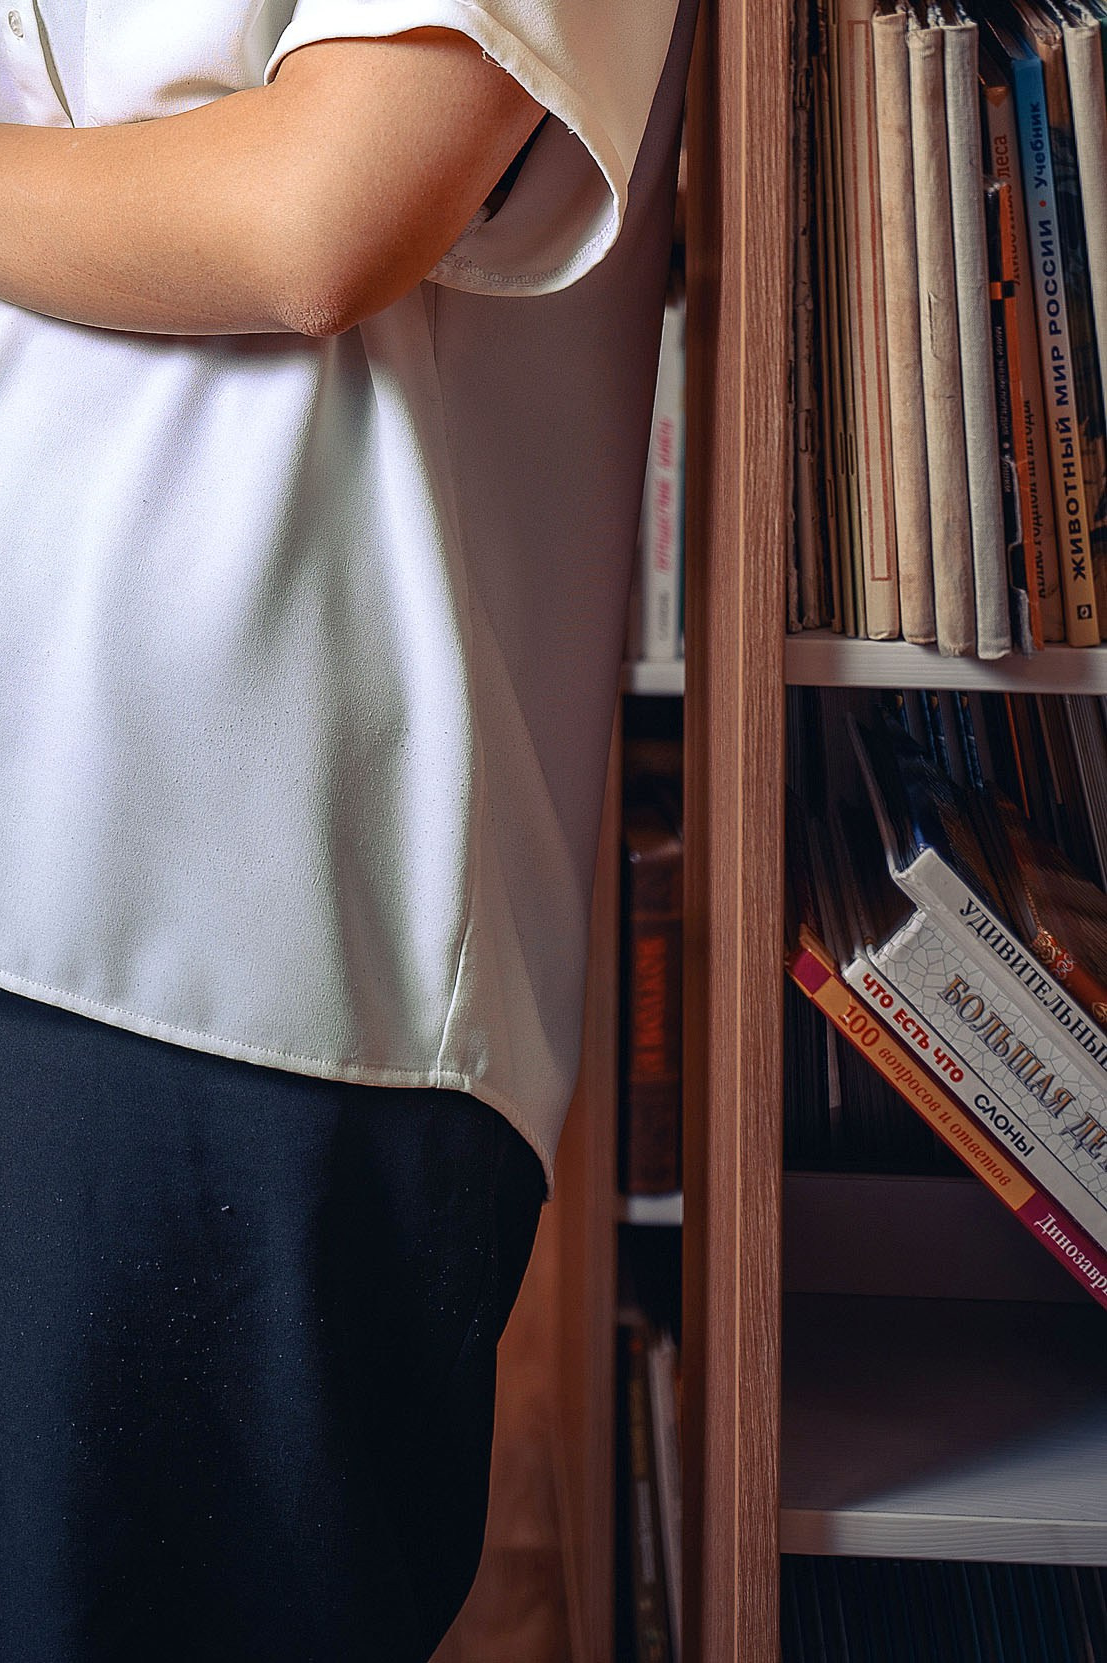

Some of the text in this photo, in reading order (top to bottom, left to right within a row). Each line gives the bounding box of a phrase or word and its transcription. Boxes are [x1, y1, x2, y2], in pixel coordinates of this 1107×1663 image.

[995, 134, 1011, 178] леса
[1030, 101, 1088, 582] ЖИВОТНЫЙ МИР РОССИИ Учебник
[837, 1004, 1107, 1297] 100 вопросов и ответов Динозавр
[862, 973, 1036, 1157] ЧТО ЕСТЬ ЧТО СЛОНЫ
[937, 974, 1107, 1174] БОЛЬШАЯ ДЕ
